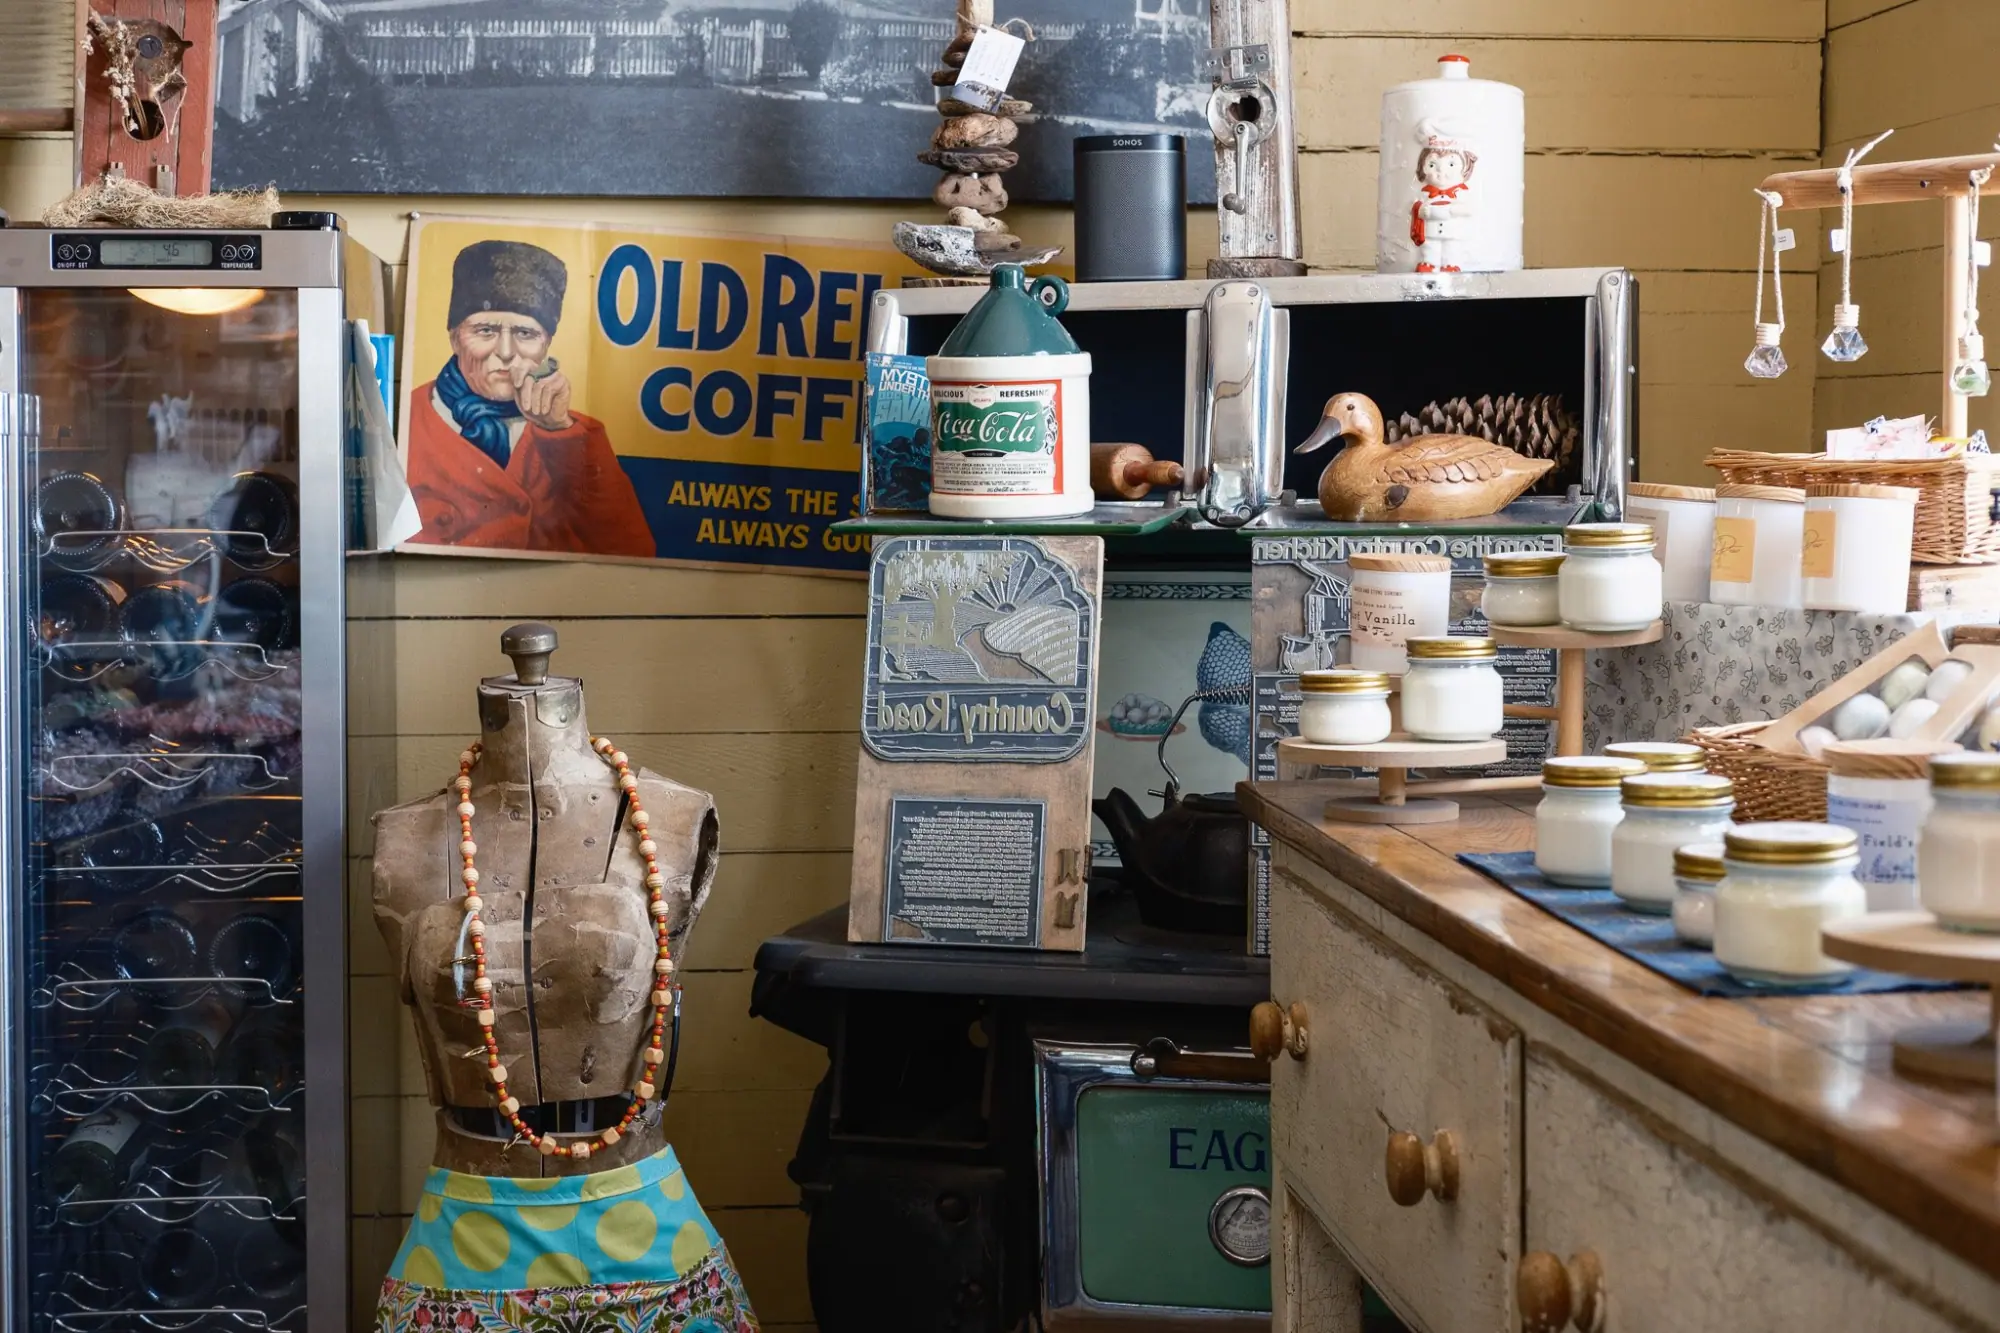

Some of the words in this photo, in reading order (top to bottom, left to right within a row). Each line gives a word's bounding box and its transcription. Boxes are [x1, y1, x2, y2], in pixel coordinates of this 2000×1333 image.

[1112, 139, 1143, 147] SONOS
[597, 244, 748, 351] OLD
[879, 381, 916, 397] UNDER
[880, 368, 930, 397] MYST
[641, 366, 864, 444] COFF
[667, 480, 771, 511] ALWAYS
[786, 488, 838, 515] THE
[696, 518, 809, 549] ALWAYS
[1364, 610, 1416, 626] Vanilla
[1169, 1127, 1267, 1173] EAG
